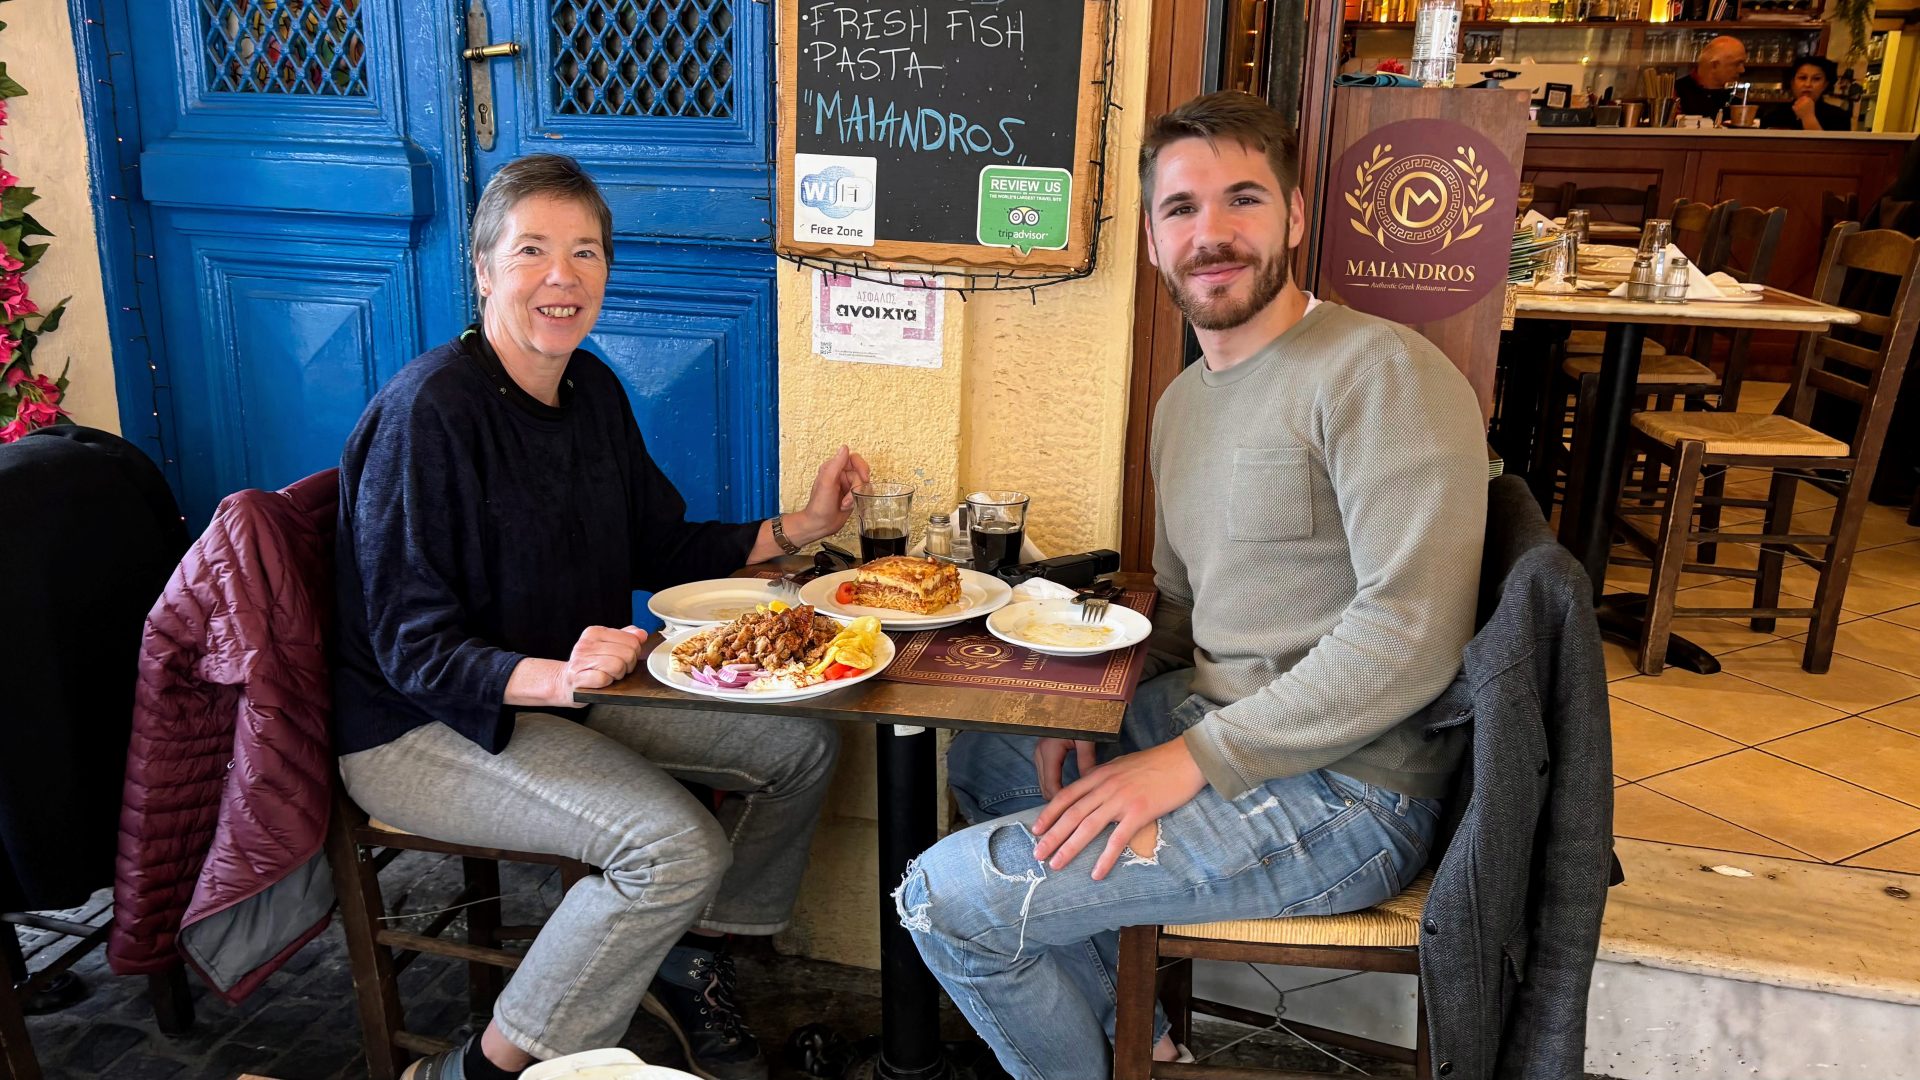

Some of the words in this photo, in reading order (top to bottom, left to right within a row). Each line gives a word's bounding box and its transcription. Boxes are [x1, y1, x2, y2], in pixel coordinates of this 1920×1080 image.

[810, 2, 927, 44] FRESH
[946, 10, 1024, 51] FISH
[810, 41, 943, 88] PASTA
[1551, 113, 1580, 123] TEA
[991, 179, 1040, 192] REVIEW
[1045, 181, 1061, 193] US
[811, 224, 833, 235] Free
[837, 225, 863, 237] Zone
[998, 229, 1046, 240] tripadvisor
[1345, 259, 1476, 283] MAIANDROS
[1371, 281, 1397, 290] Authentic
[1398, 282, 1415, 291] Greek
[1415, 283, 1447, 293] Restaurant
[836, 301, 917, 321] ανοιχτά
